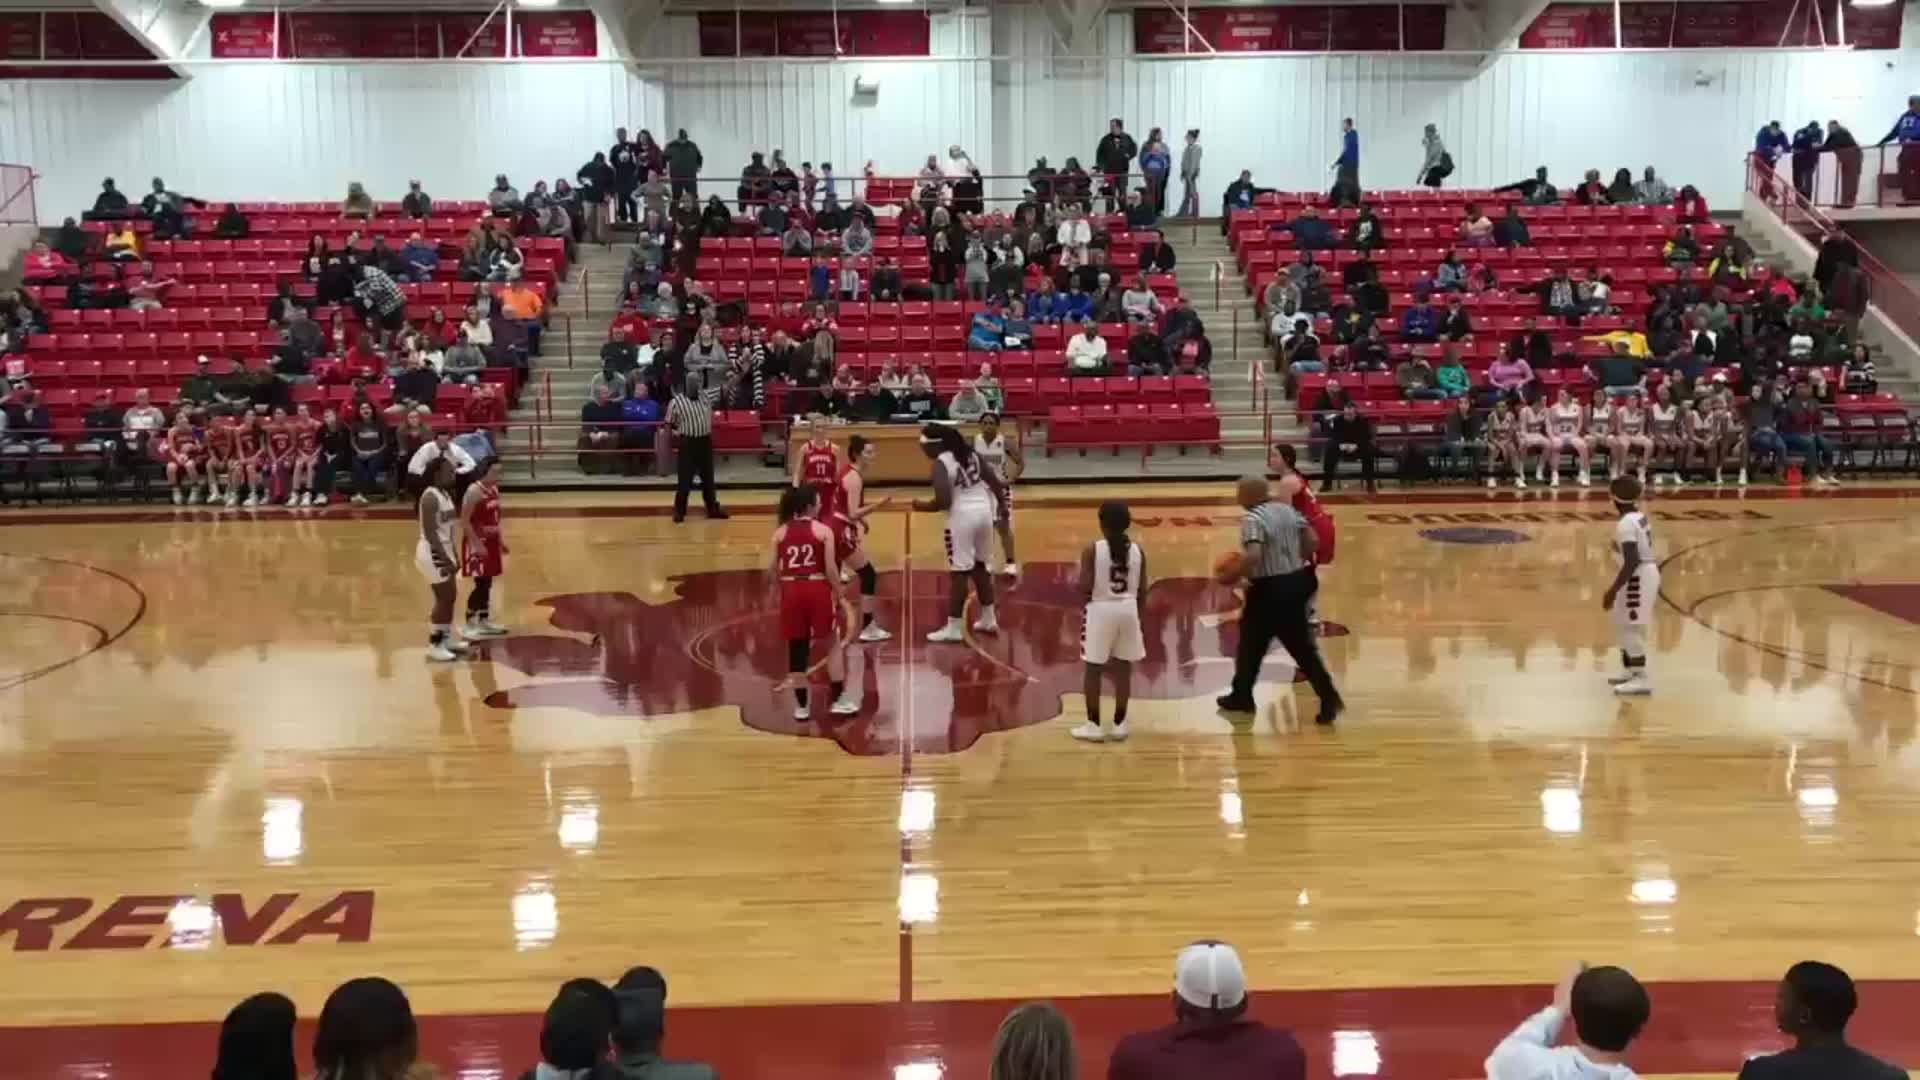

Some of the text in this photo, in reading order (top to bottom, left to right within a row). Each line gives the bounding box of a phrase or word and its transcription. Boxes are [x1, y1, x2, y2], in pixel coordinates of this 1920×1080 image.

[815, 463, 827, 475] 11
[786, 543, 817, 569] 22
[1110, 564, 1130, 594] 5
